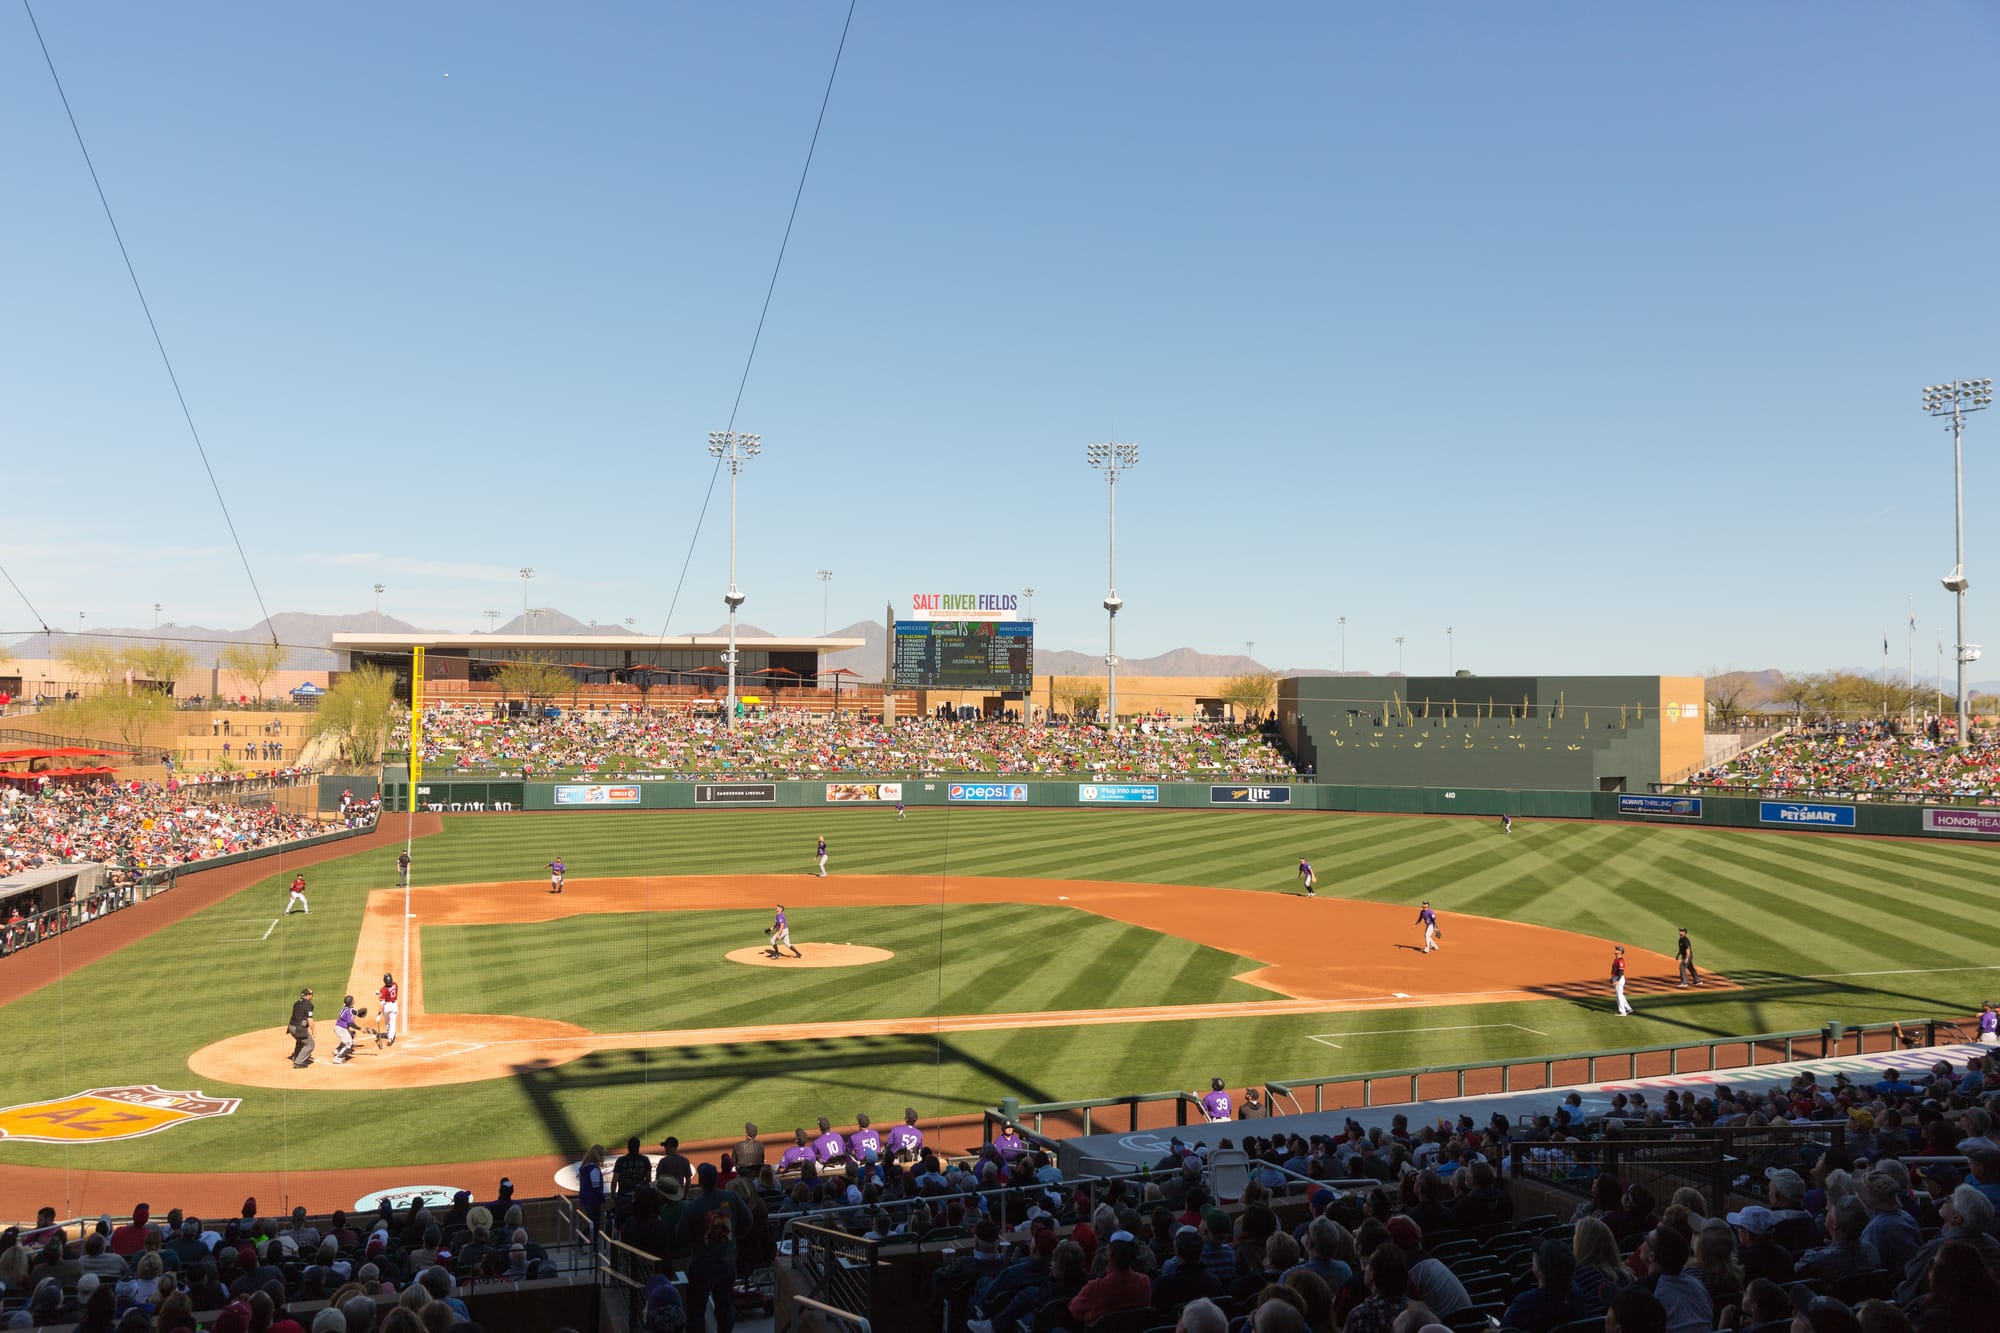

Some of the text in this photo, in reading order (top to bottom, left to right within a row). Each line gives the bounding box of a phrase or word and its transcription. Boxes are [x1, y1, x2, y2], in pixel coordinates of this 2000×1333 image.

[913, 594, 1017, 610] SALT RIVER FIELDS
[958, 621, 968, 636] VS
[965, 785, 1005, 800] pepsi
[1248, 788, 1270, 802] Lite
[1216, 1098, 1228, 1110] 39
[19, 1107, 149, 1132] AZ
[827, 1140, 840, 1155] 10
[862, 1138, 878, 1151] 58
